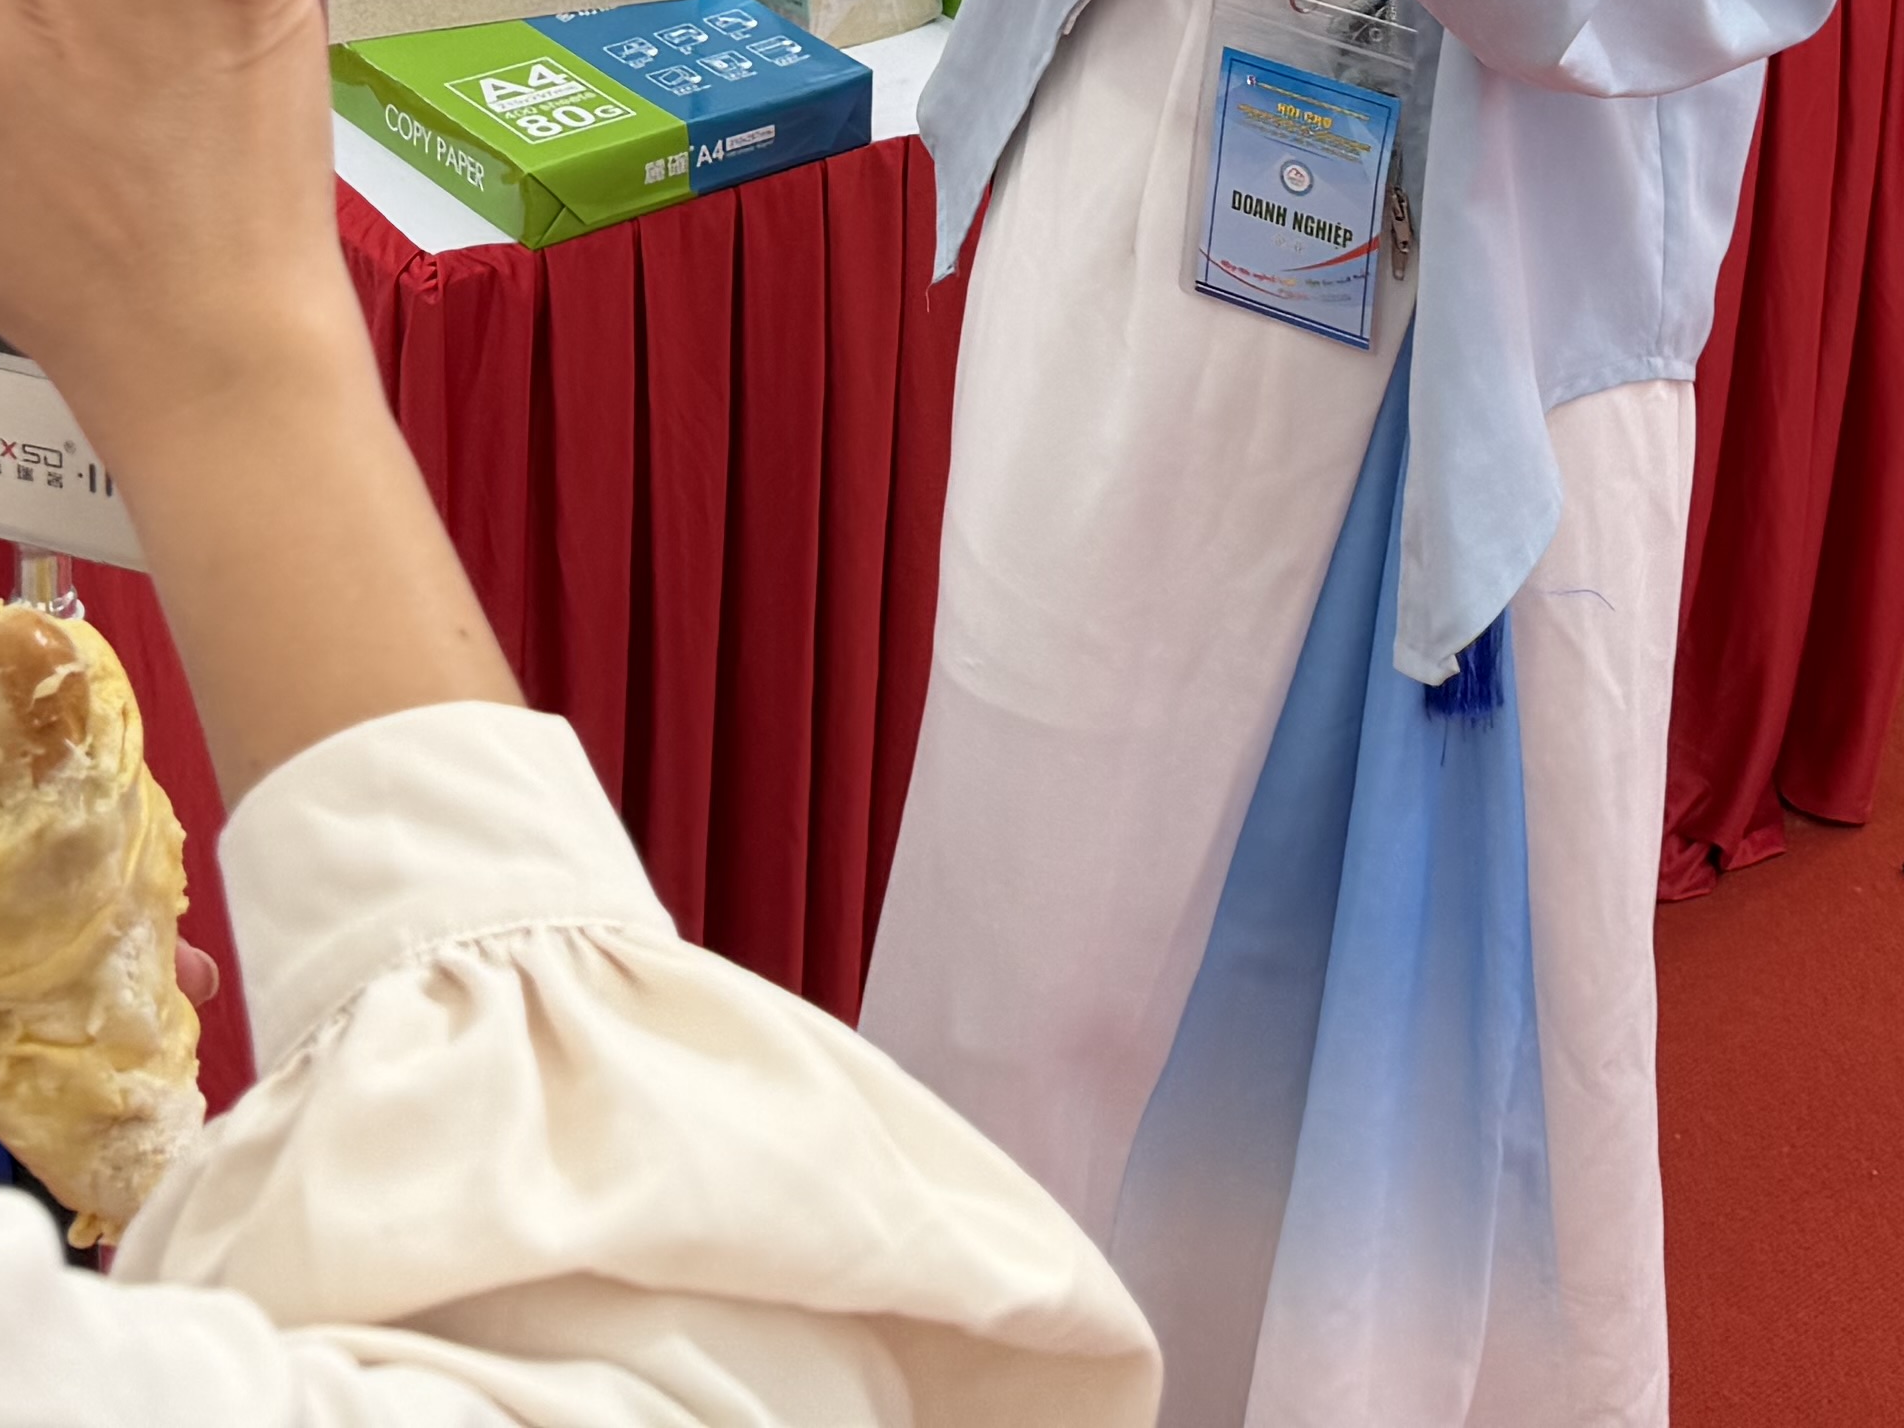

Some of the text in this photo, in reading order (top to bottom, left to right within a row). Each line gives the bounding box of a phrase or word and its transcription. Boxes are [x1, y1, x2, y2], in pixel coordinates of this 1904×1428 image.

[478, 62, 570, 106] A4
[385, 103, 485, 192] COPY PAPER
[696, 139, 725, 168] A4
[1231, 189, 1288, 228] DOANH
[1291, 209, 1354, 251] NGHIỆP
